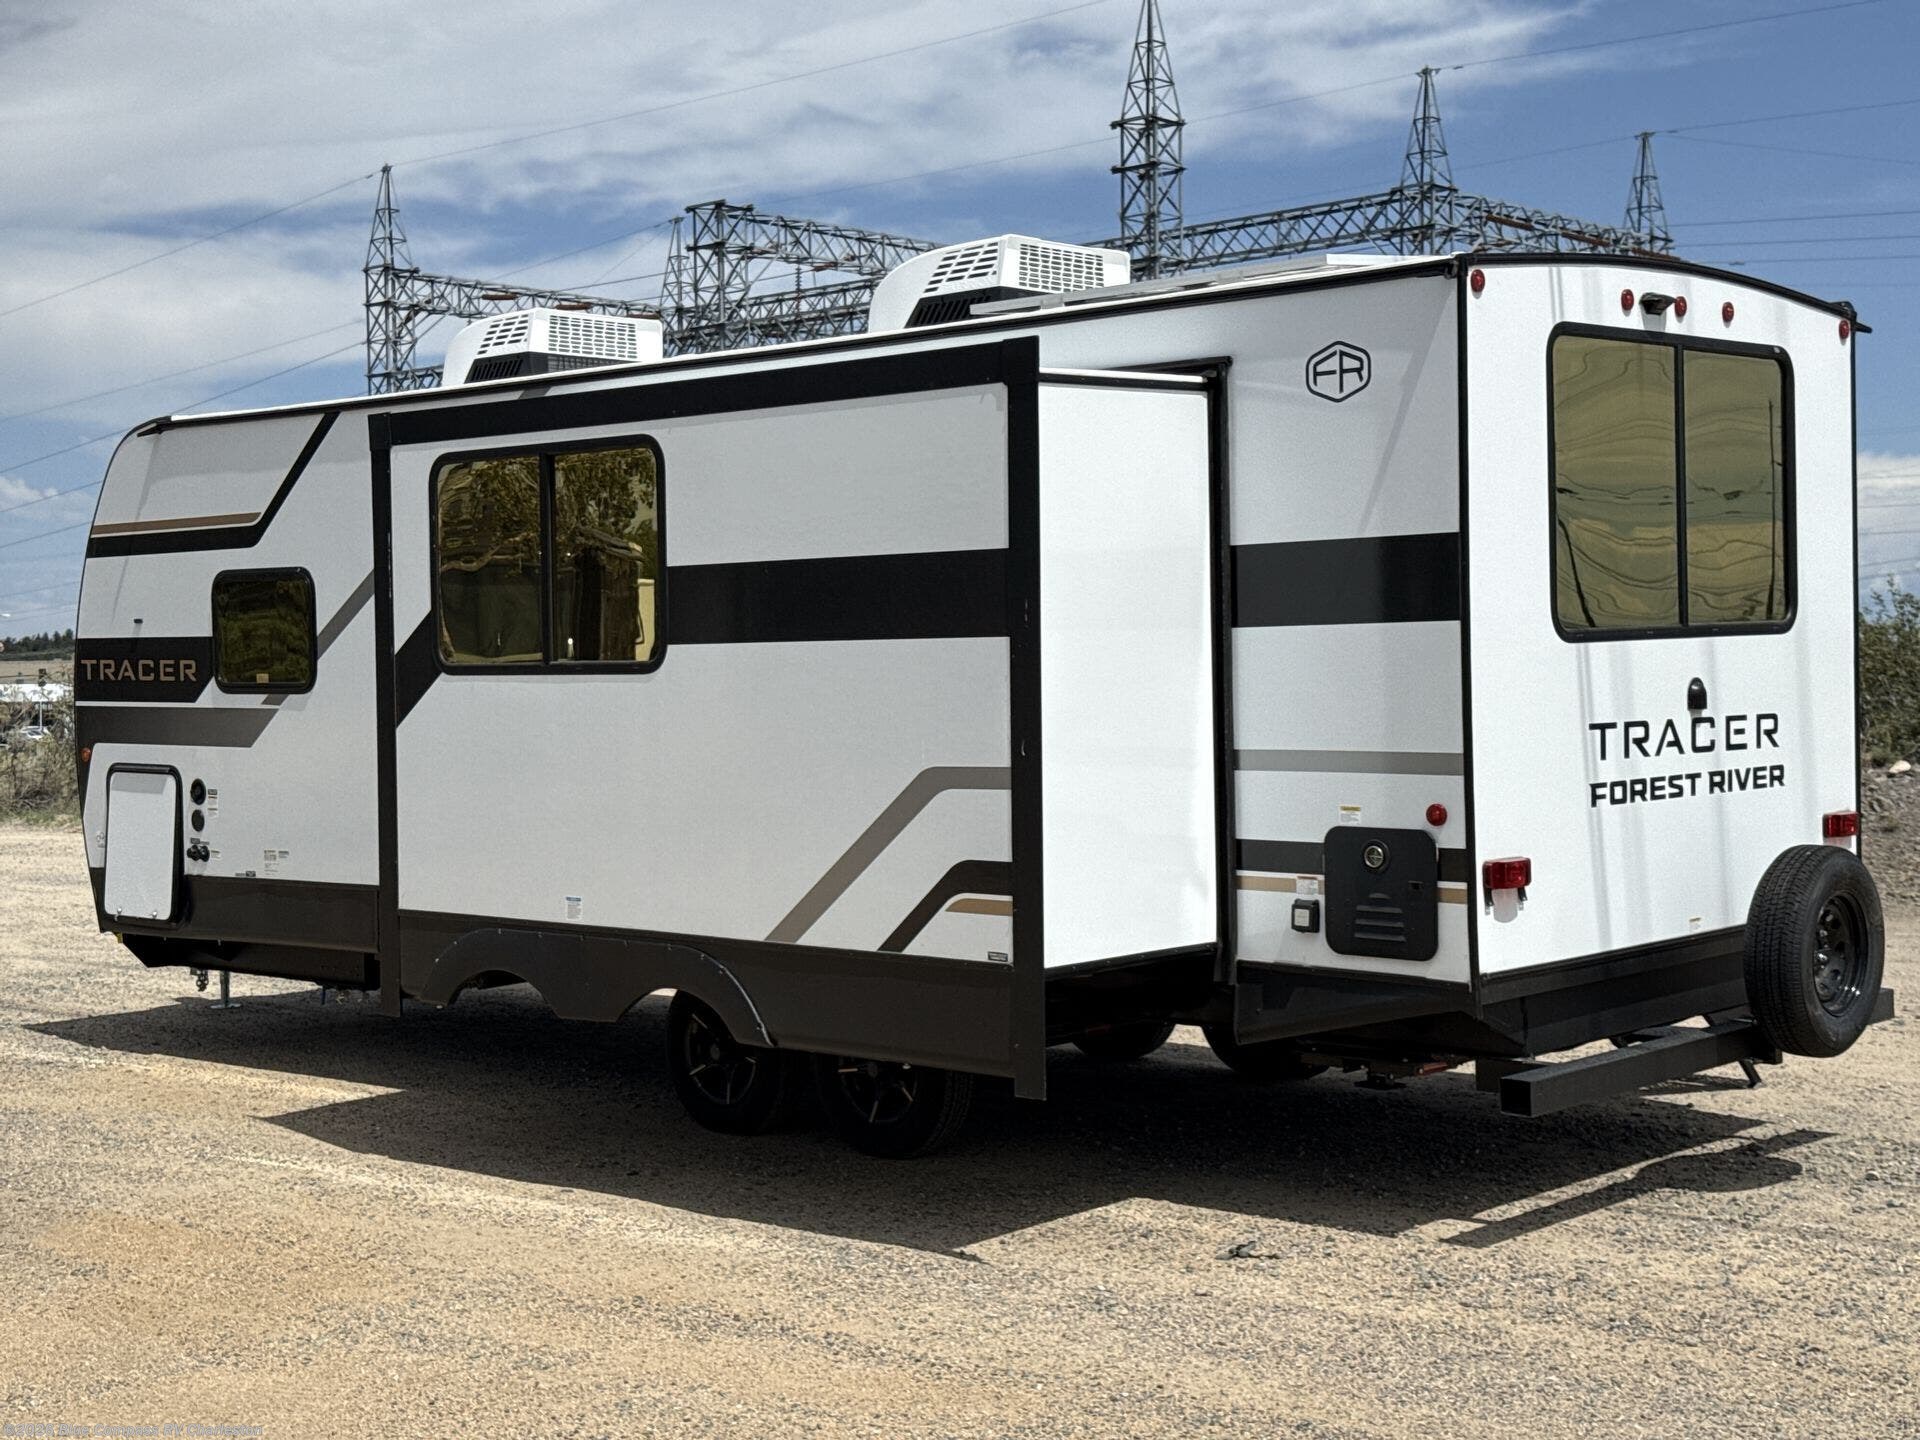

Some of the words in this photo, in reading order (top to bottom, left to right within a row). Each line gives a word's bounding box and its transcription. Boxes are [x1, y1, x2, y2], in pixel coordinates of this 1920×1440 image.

[80, 658, 198, 682] TRACER
[1588, 712, 1780, 761] TRACER
[1588, 771, 1702, 808] FOREST
[1707, 763, 1786, 795] RIVER
